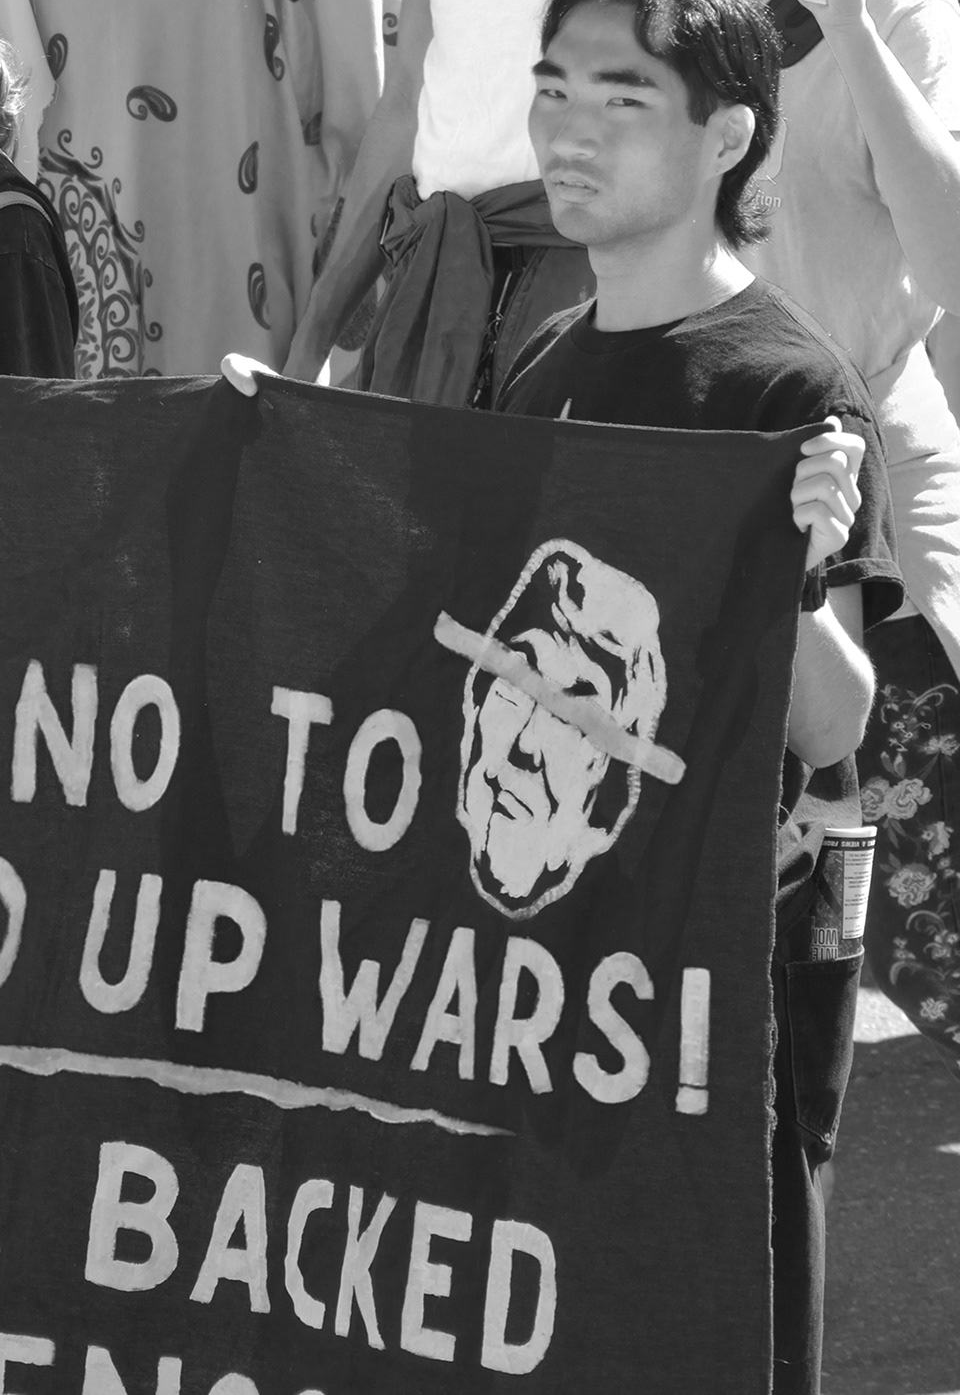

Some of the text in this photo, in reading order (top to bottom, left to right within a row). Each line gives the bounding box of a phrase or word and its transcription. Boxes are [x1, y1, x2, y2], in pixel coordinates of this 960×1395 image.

[11, 659, 180, 812] NO
[271, 685, 422, 852] TO
[79, 868, 267, 1032] UP
[319, 899, 711, 1115] WARS!
[84, 1140, 557, 1375] BACKED
